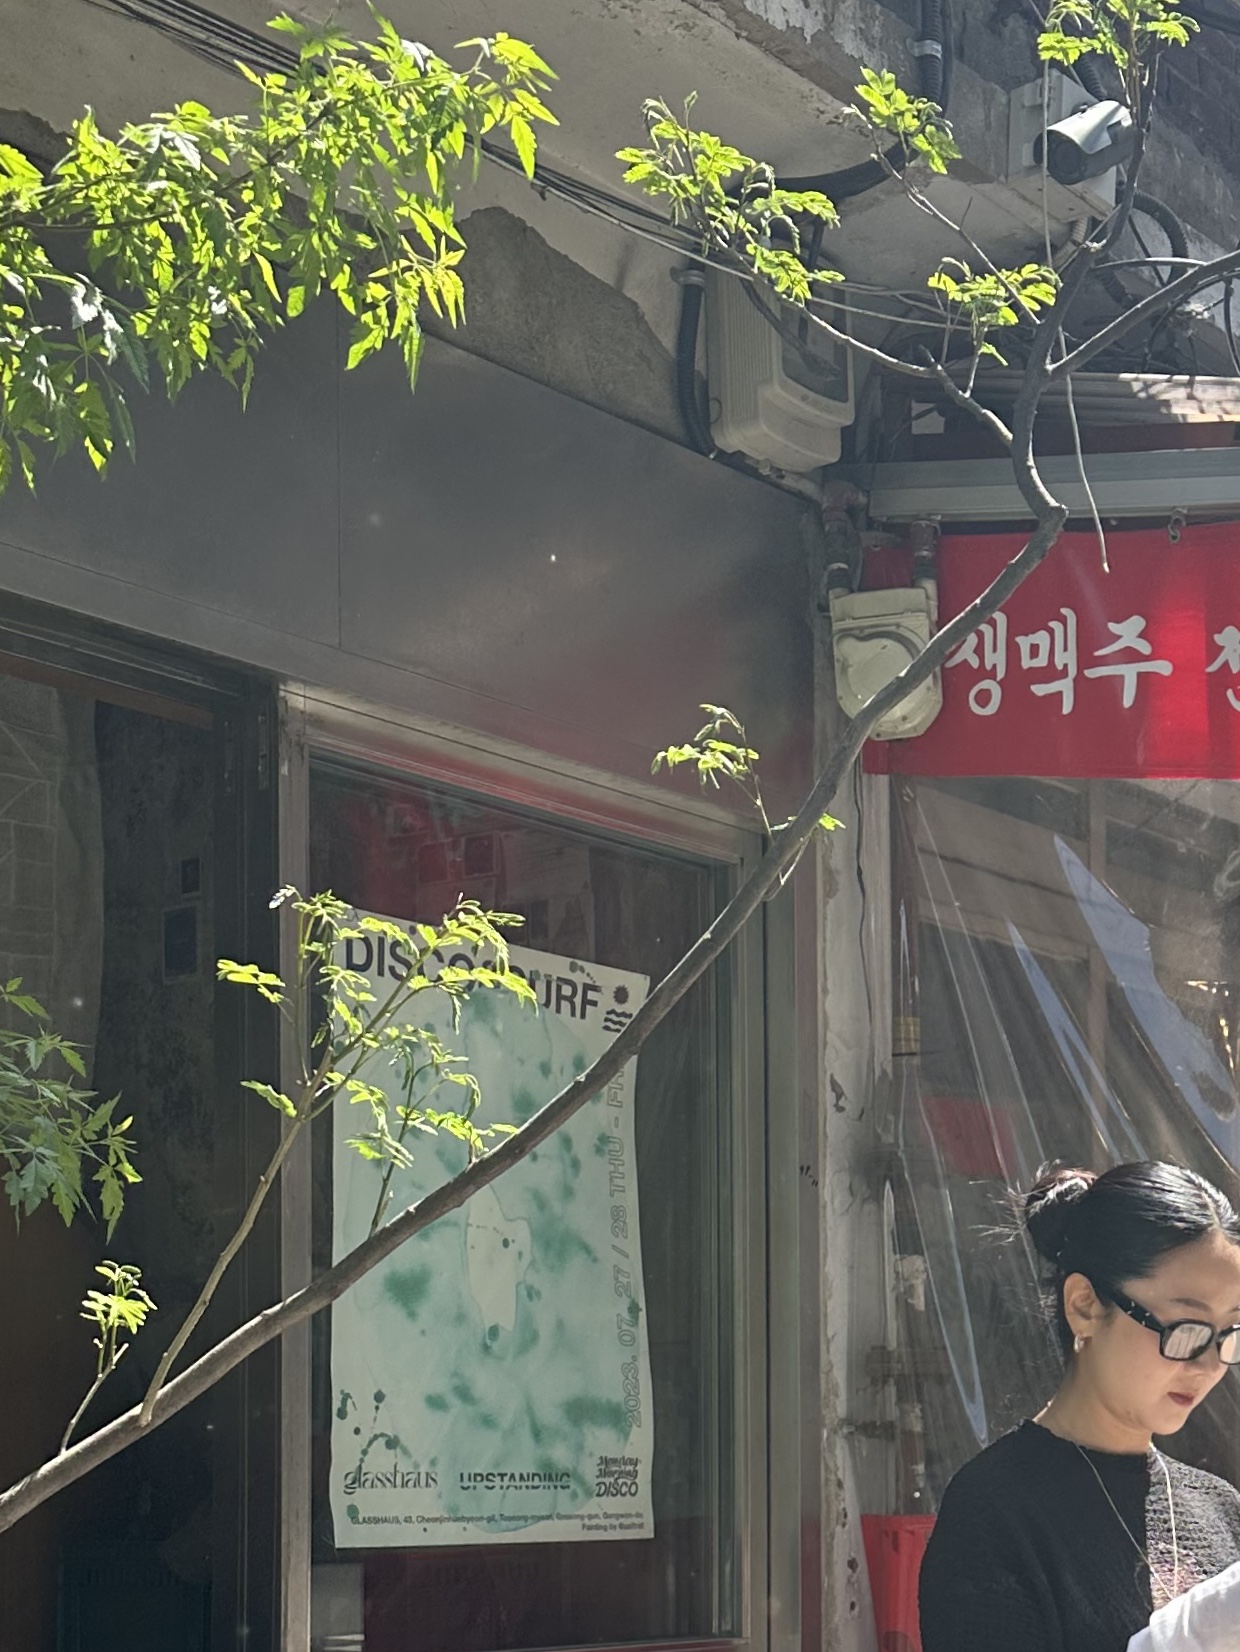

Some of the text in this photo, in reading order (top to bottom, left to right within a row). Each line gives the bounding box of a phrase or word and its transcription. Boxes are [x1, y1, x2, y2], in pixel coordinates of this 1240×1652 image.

[943, 606, 1173, 716] 생맥주
[606, 1138, 626, 1204] THU
[608, 1204, 628, 1239] 28
[611, 1266, 631, 1297] 27
[620, 1353, 641, 1429] 2023.
[595, 1480, 639, 1498] DISCO
